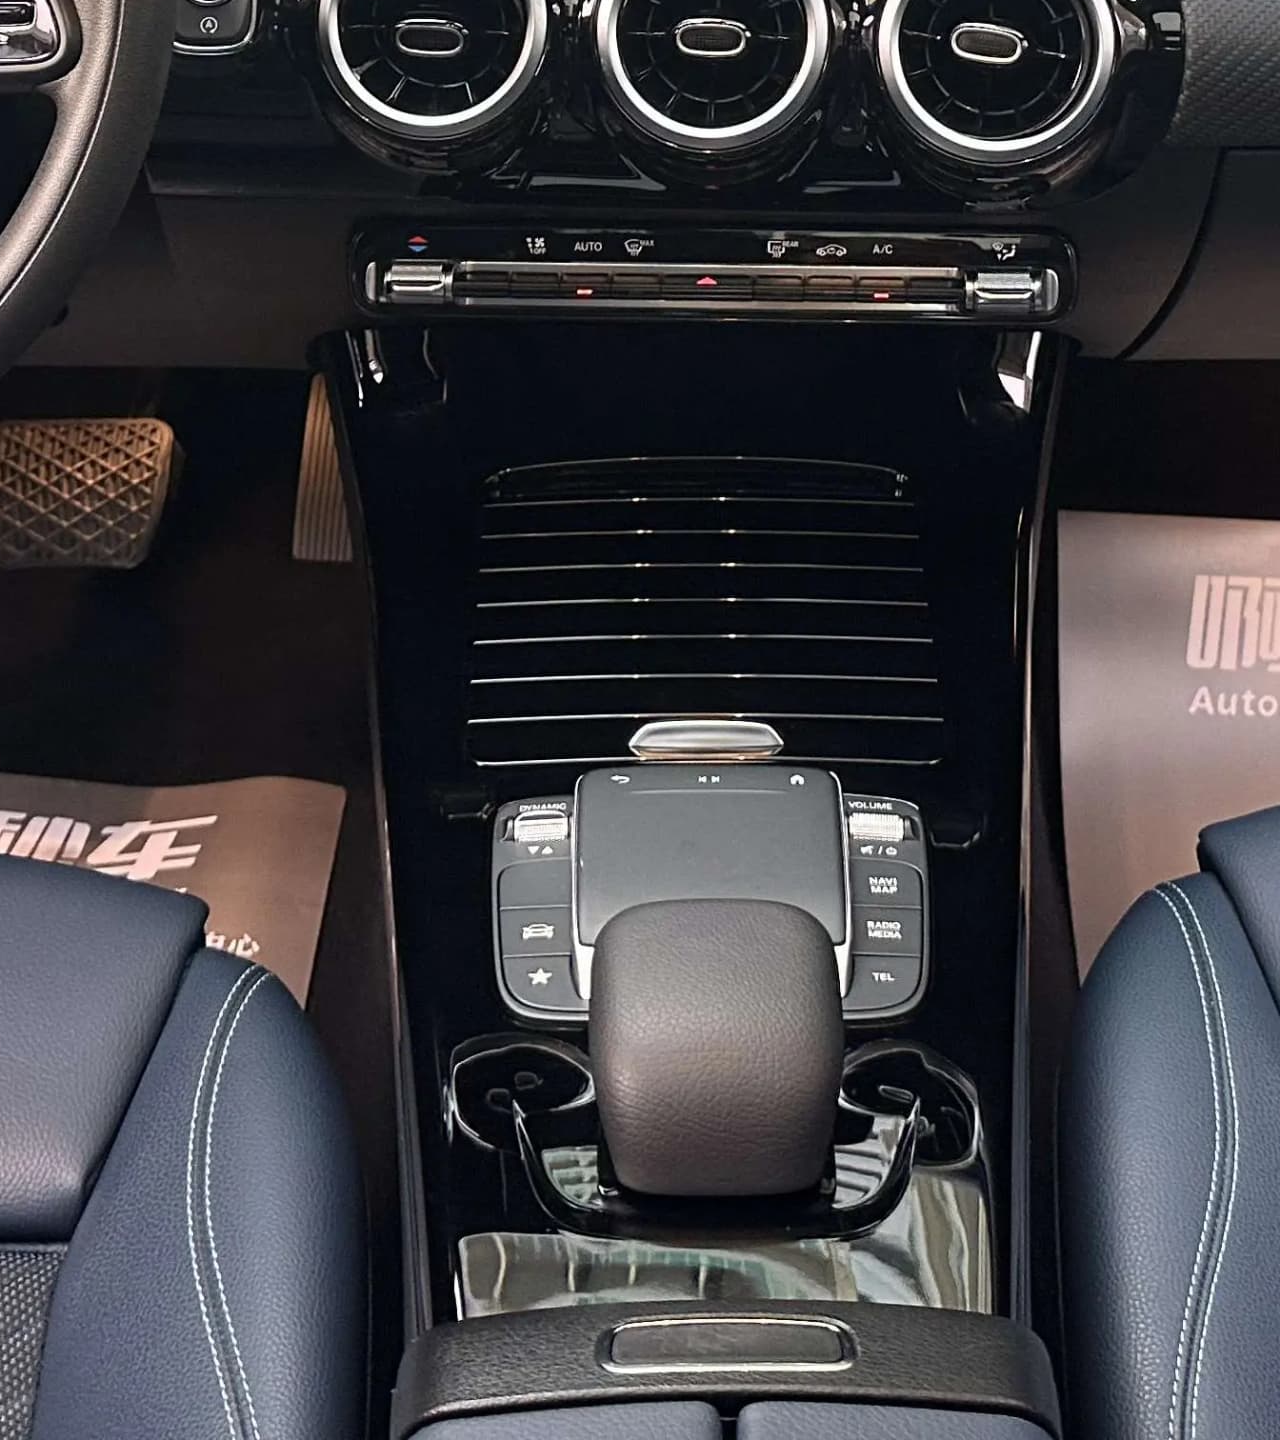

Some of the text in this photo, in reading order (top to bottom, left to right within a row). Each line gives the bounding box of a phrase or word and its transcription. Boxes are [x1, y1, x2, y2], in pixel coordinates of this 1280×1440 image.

[573, 241, 603, 252] AUTO
[872, 244, 894, 254] A/C
[519, 802, 567, 812] DYNAMIC
[848, 801, 893, 810] VOLUME
[869, 876, 898, 886] NAVI
[870, 885, 898, 894] MAP
[867, 921, 902, 930] RADIO
[867, 929, 903, 939] MEDIA
[872, 972, 895, 982] TEL
